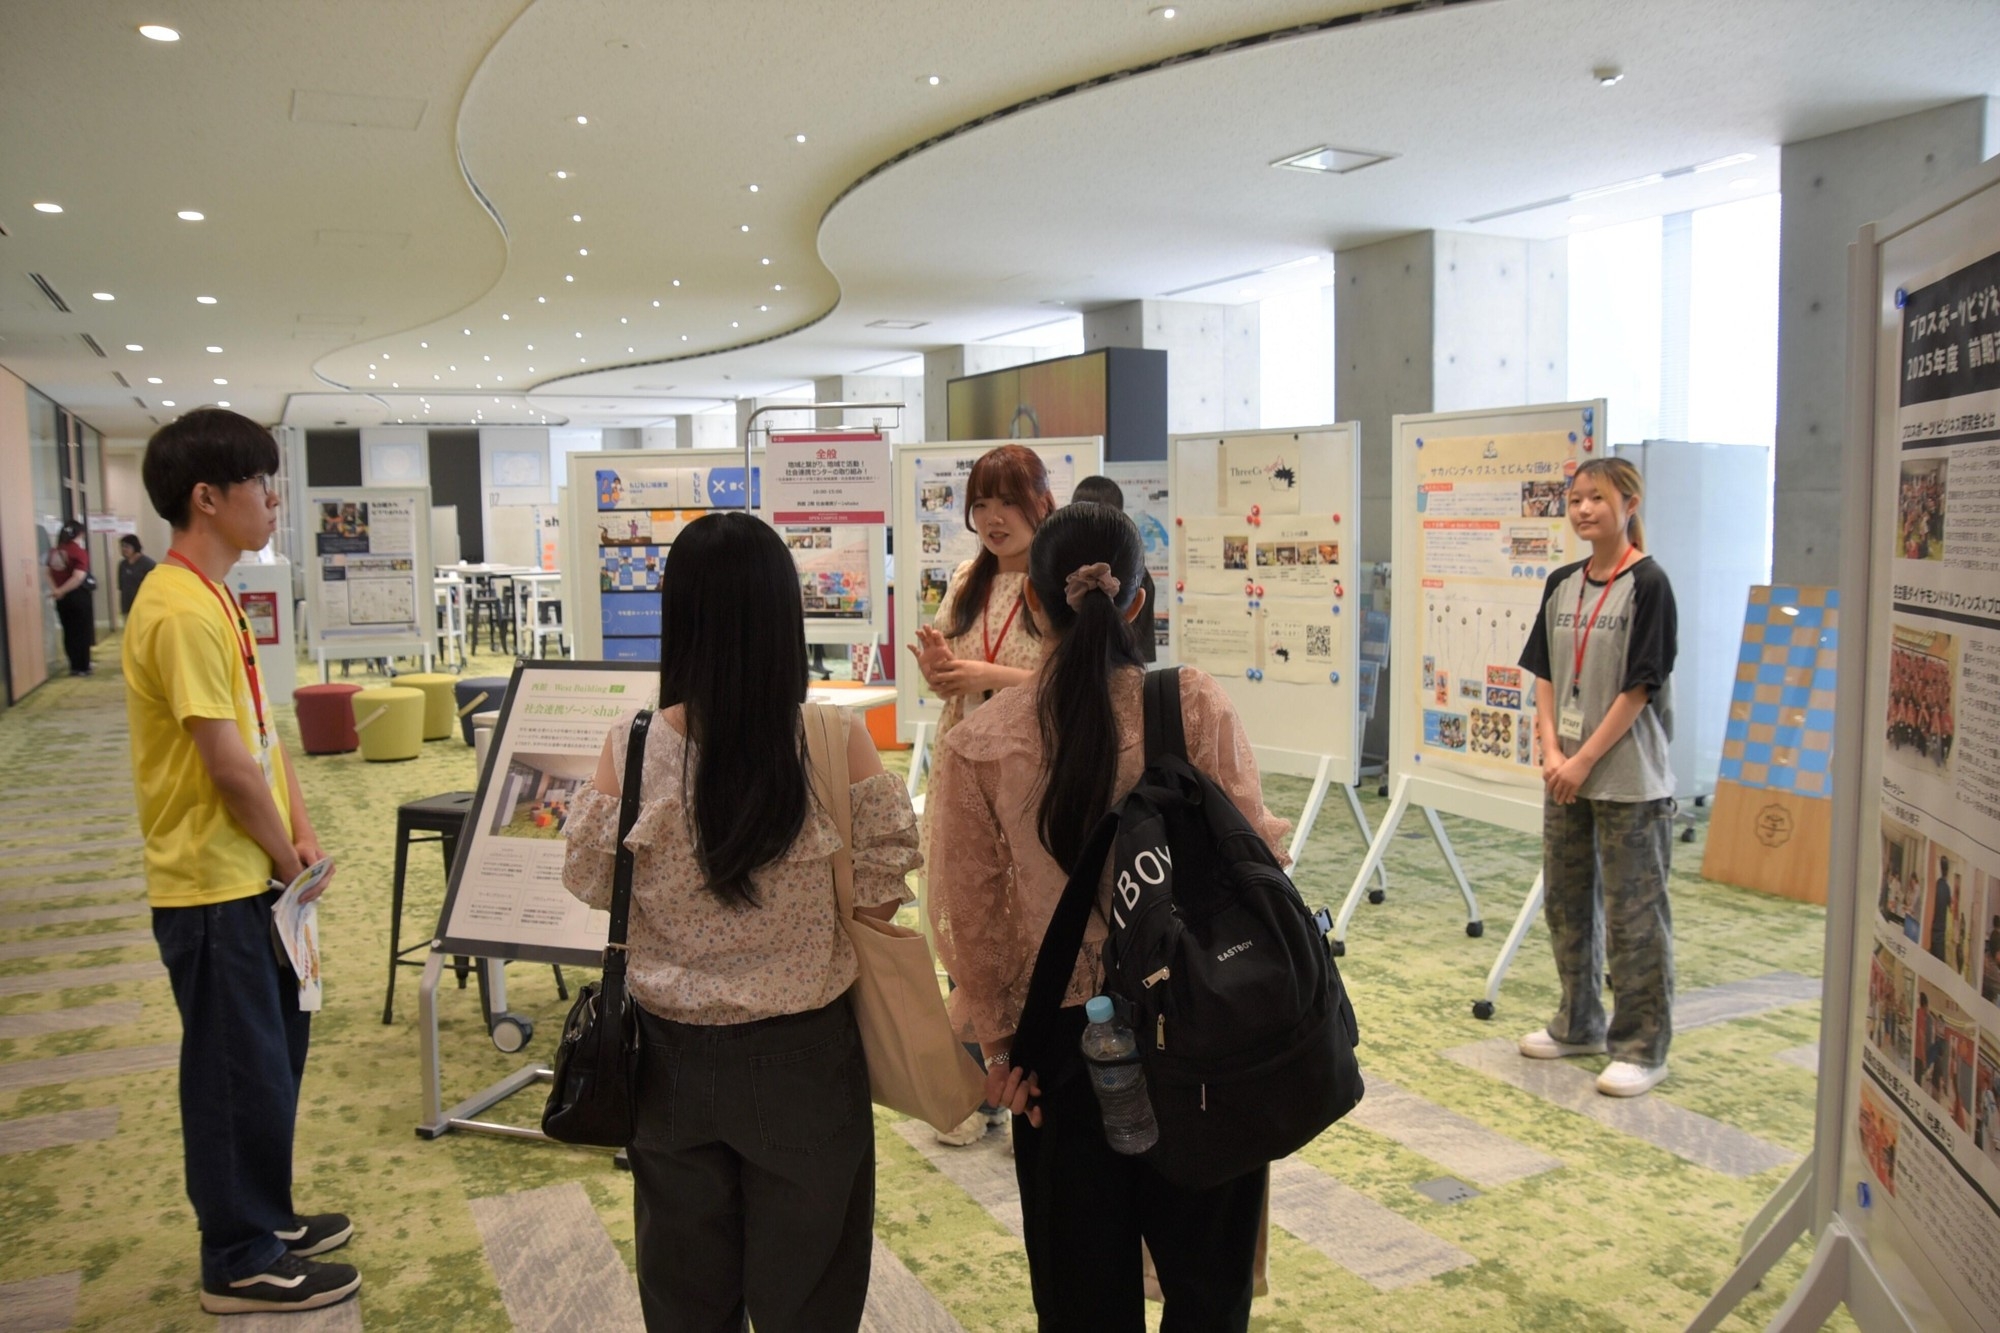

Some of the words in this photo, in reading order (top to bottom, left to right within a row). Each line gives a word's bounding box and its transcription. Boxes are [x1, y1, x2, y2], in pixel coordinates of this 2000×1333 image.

[1907, 344, 1959, 381] 2025年度
[816, 448, 837, 459] 全般
[1217, 940, 1253, 961] EASTBOY
